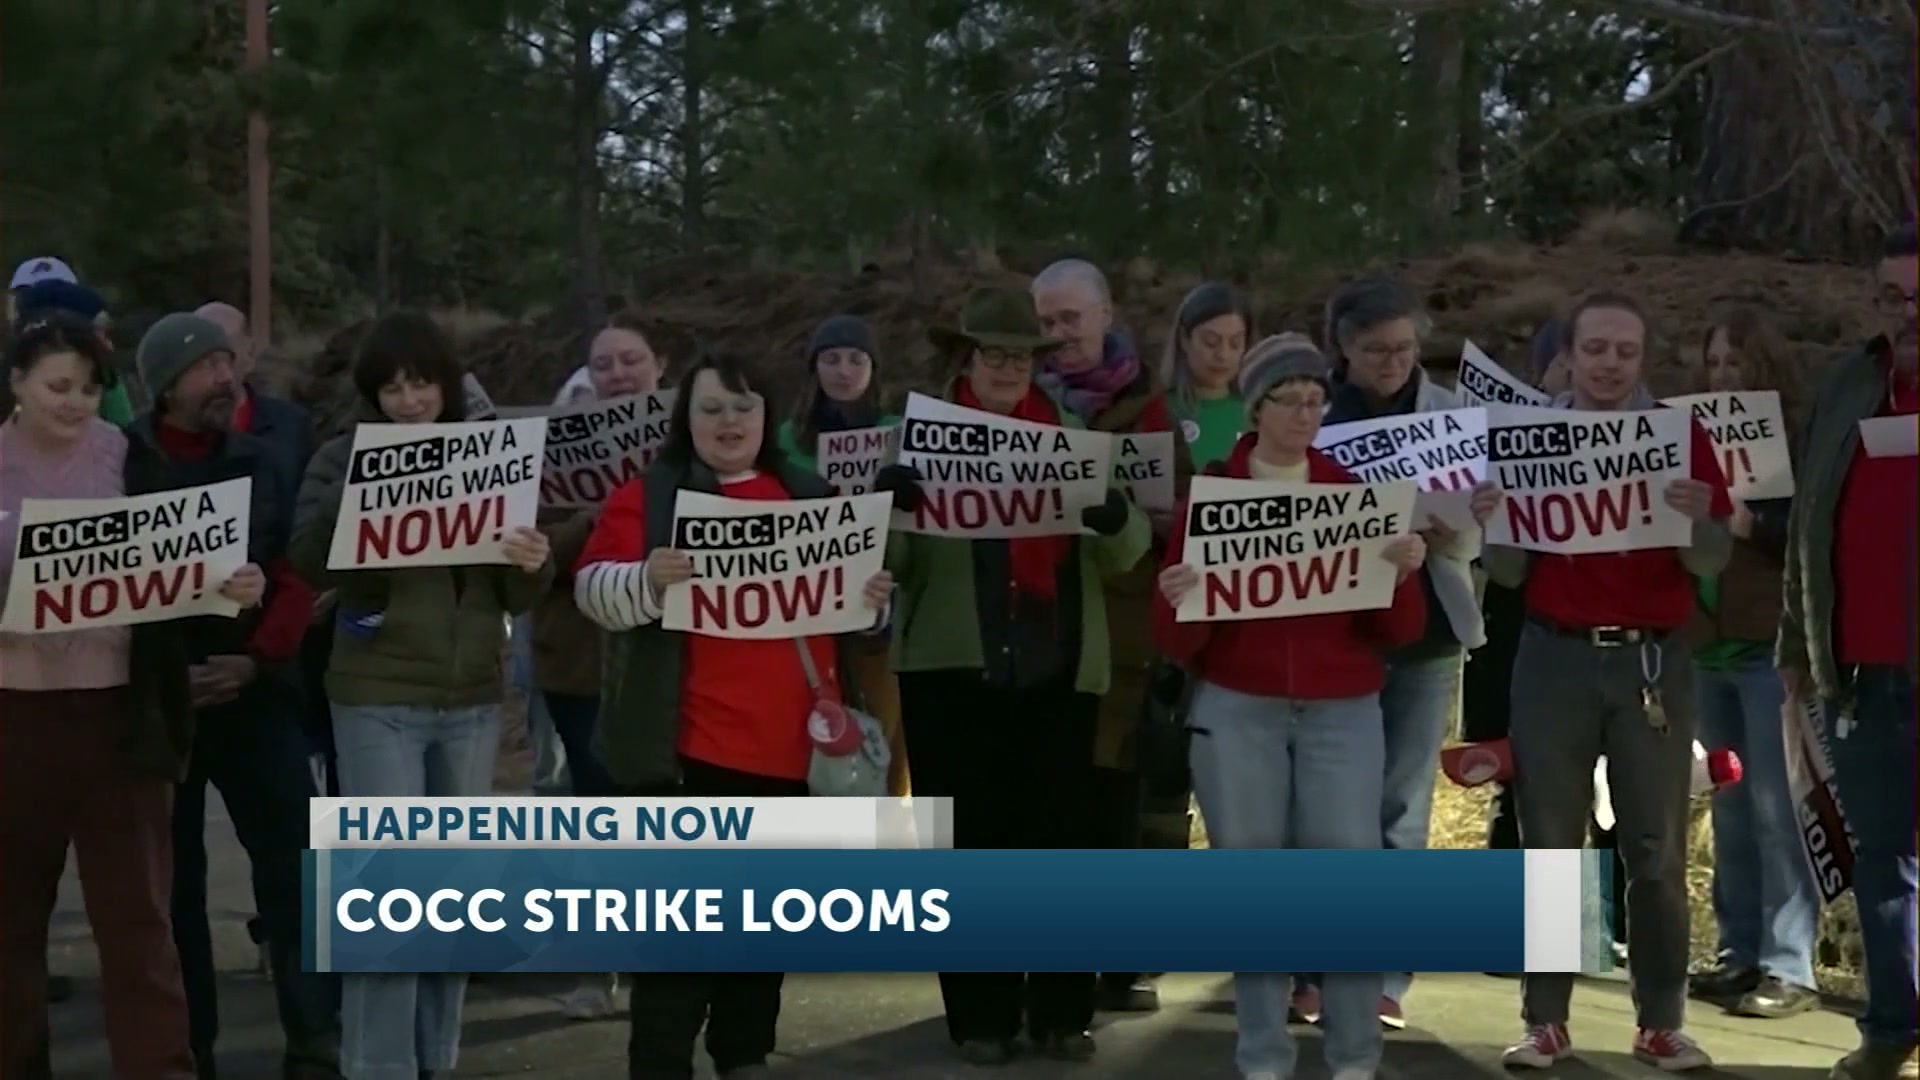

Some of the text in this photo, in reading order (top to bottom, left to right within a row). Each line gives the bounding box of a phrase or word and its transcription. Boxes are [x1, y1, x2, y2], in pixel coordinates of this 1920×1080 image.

[590, 402, 635, 432] PAY
[647, 395, 664, 415] A
[1692, 396, 1746, 419] AY A
[361, 425, 517, 478] COCC: PAY A
[543, 419, 671, 467] VING WAG
[828, 435, 857, 455] NO
[912, 420, 1072, 453] COCC: PAY A
[1121, 438, 1139, 457] A
[1323, 414, 1462, 467] OCC: PAY A
[1354, 457, 1418, 484] VING
[1418, 435, 1487, 470] WAGE
[1496, 416, 1654, 457] COCC: PAY A
[360, 455, 534, 512] LIVING WAGE
[1011, 459, 1096, 481] WAGE
[1114, 459, 1163, 481] AGE
[1499, 460, 1587, 490] LIVING
[1597, 443, 1680, 480] WAGE
[32, 491, 215, 552] COCC: PAY A
[356, 495, 505, 564] NOW!
[685, 501, 856, 547] COCC: PAY A
[915, 488, 1064, 530] NOW!
[1200, 488, 1378, 532] COCC: PAY A
[1506, 481, 1653, 544] NOW!
[34, 518, 239, 583] LIVING WAGE
[690, 527, 875, 578] LIVING WAGE
[1204, 513, 1398, 566] LIVING WAGE
[34, 562, 204, 629] NOW!
[691, 566, 843, 630] NOW!
[1206, 547, 1359, 616] NOW!
[1802, 799, 1843, 896] STOP
